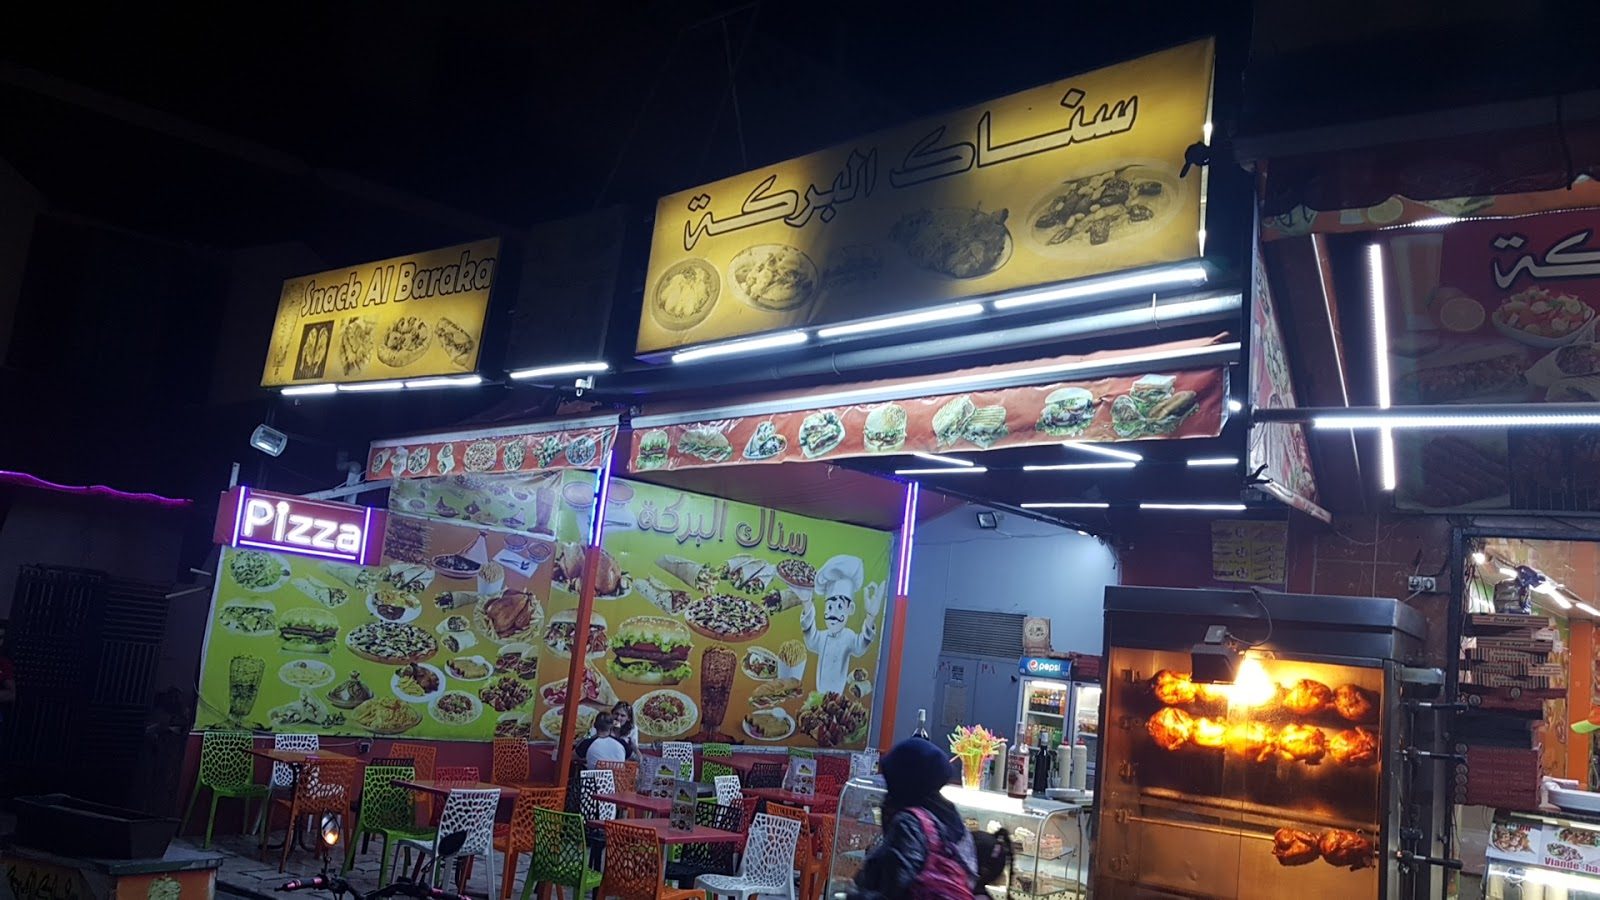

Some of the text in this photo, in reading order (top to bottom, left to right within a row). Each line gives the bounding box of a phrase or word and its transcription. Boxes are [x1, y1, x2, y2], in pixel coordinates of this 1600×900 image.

[683, 87, 1138, 251] سناك البركة
[300, 250, 496, 318] Snack Al Baraka
[240, 498, 361, 554] Pizza
[637, 492, 808, 557] سناك البركة
[1038, 662, 1061, 673] pepsi
[1544, 856, 1580, 870] Viande
